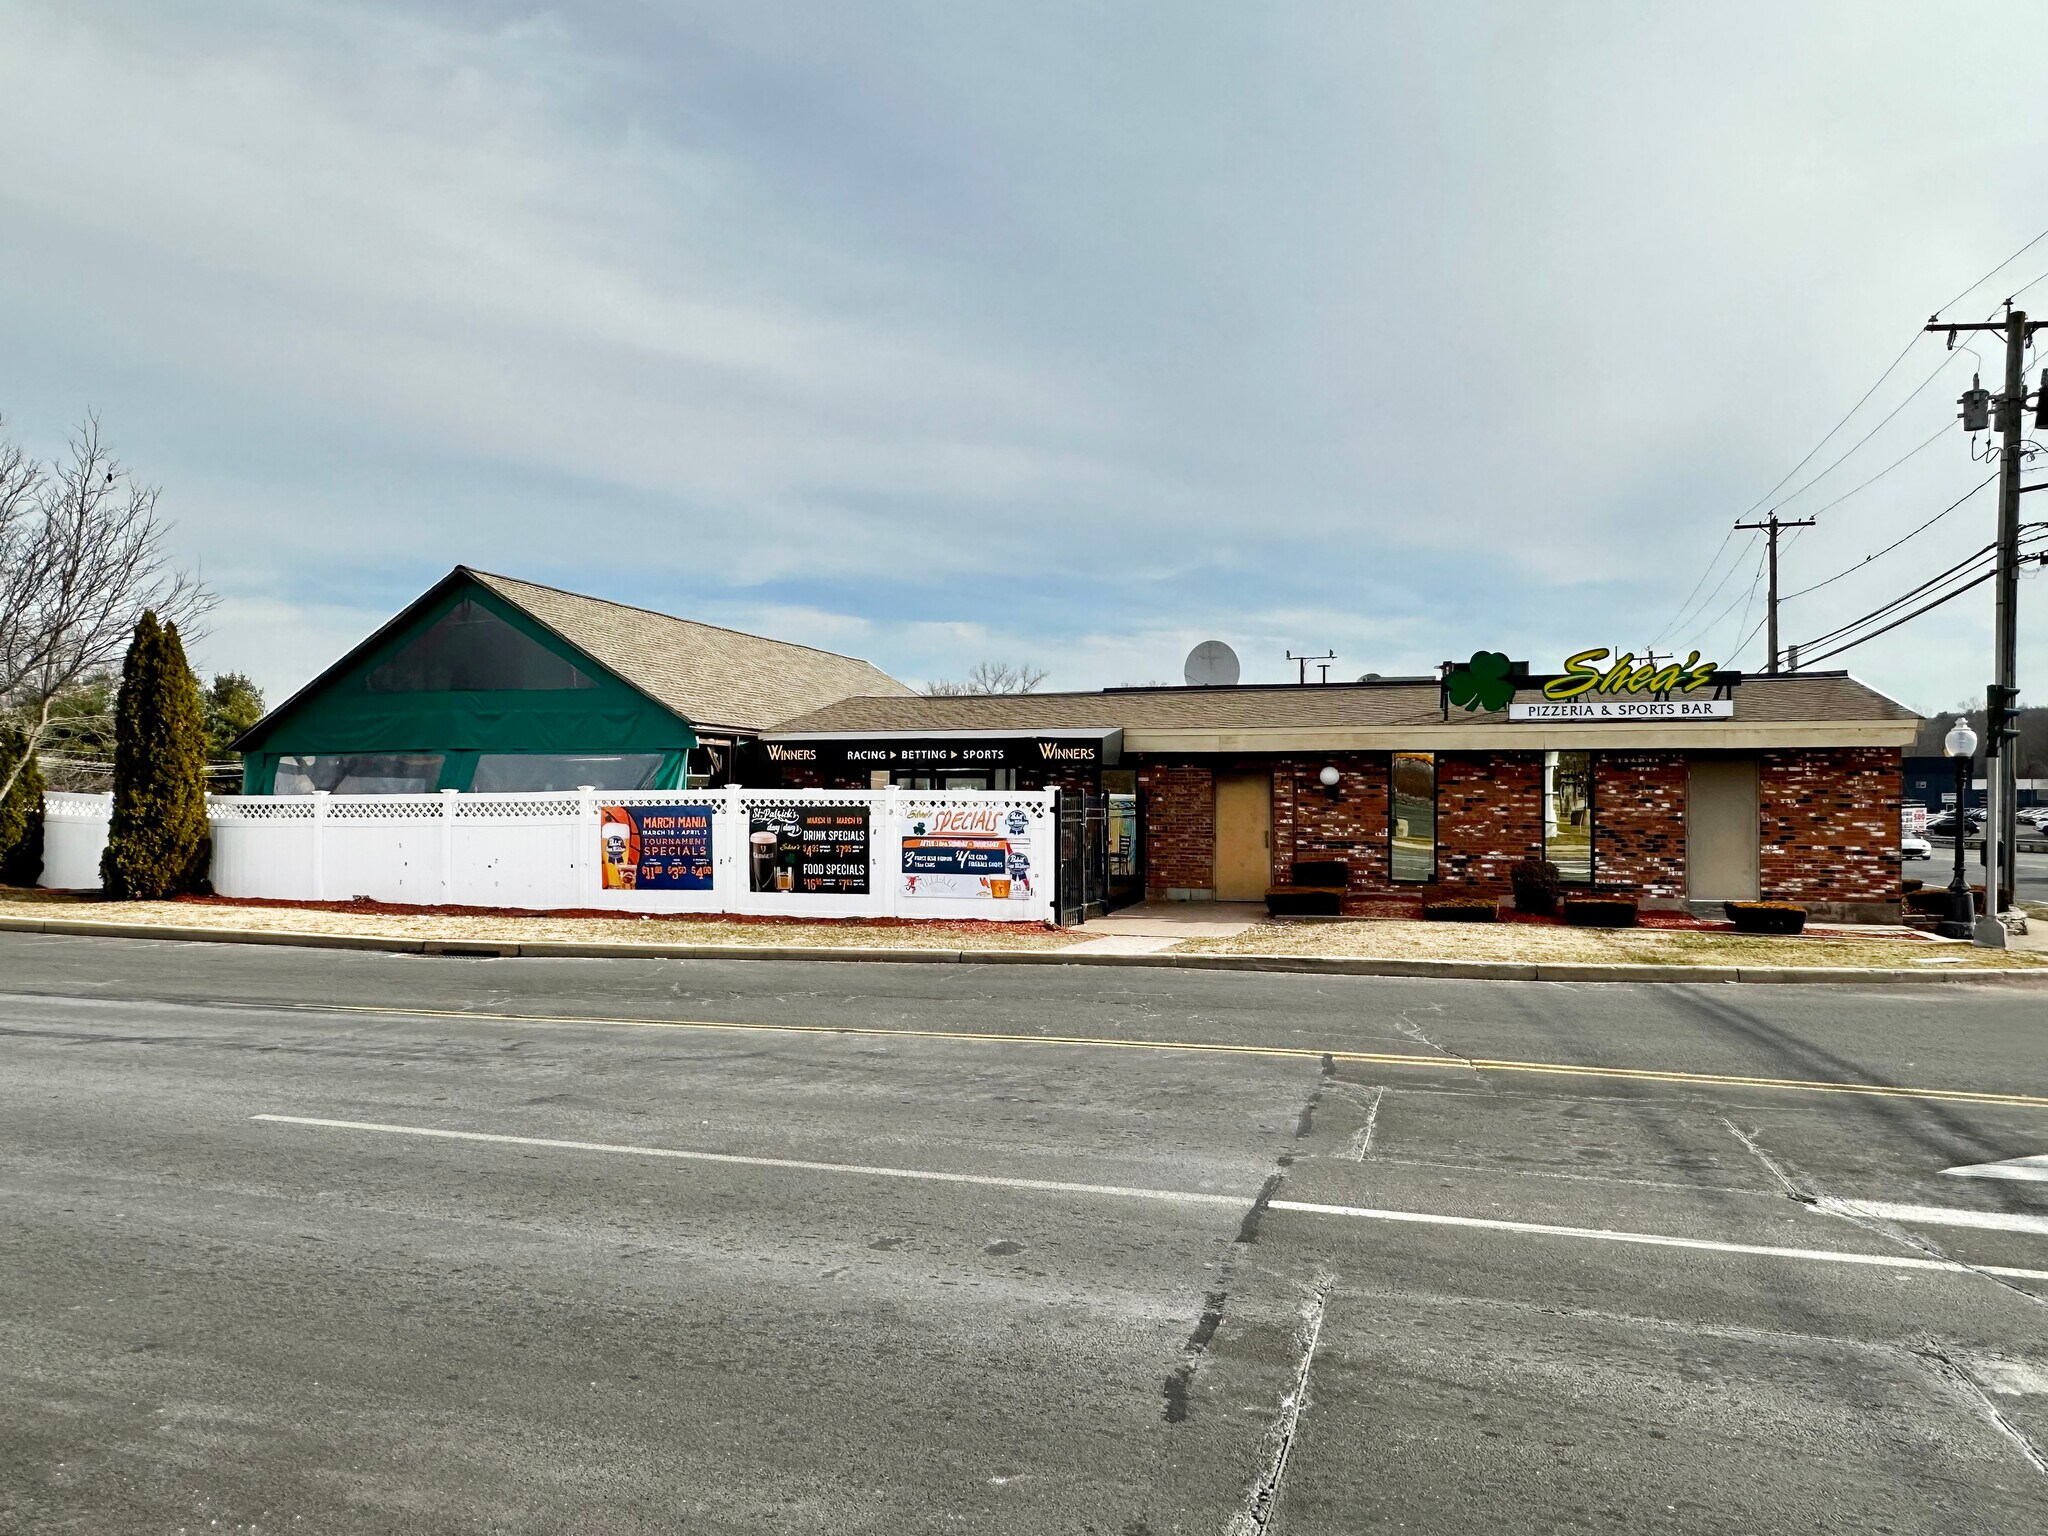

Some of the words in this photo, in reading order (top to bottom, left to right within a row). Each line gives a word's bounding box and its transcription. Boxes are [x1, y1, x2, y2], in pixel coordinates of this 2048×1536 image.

[1543, 648, 1718, 701] Shea's
[1528, 705, 1595, 717] PIZZERIA
[1601, 705, 1613, 716] &
[1618, 703, 1675, 716] SPORTS
[1681, 703, 1713, 714] BAR
[847, 751, 886, 760] RACING
[901, 751, 947, 760] BETTING
[962, 750, 1004, 760] SPORTS
[643, 816, 675, 828] MARCH
[678, 816, 707, 828] MANIA
[932, 809, 1004, 831] SPECIALS
[803, 830, 827, 841] DRINK
[828, 830, 865, 841] SPECIALS
[644, 838, 707, 846] TOURNAMENT
[644, 846, 707, 856] SPECIALS
[803, 863, 824, 875] FOOD
[826, 863, 865, 875] SPECIALS
